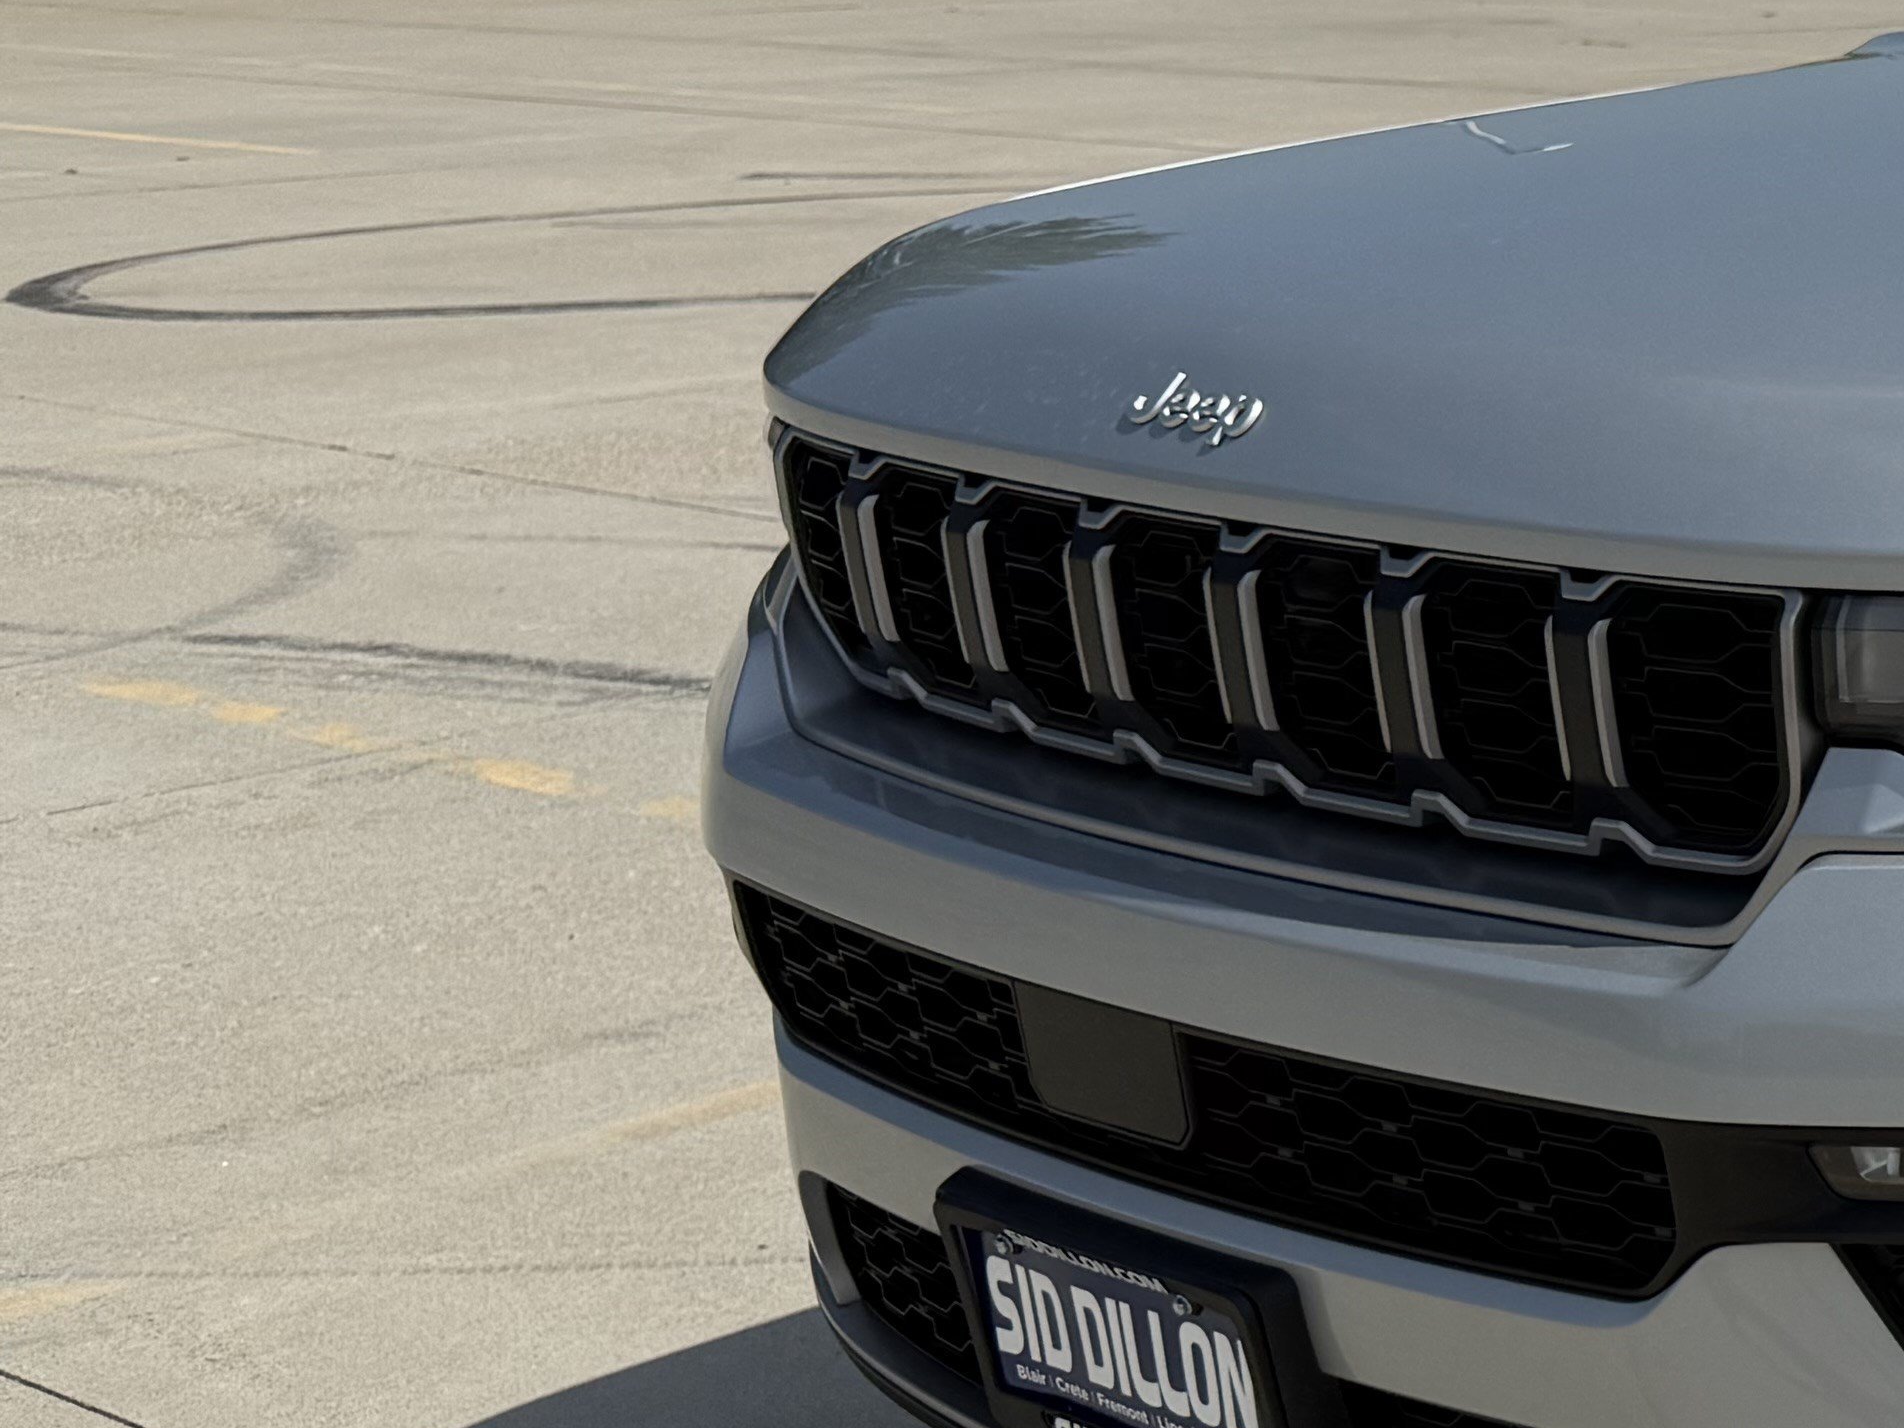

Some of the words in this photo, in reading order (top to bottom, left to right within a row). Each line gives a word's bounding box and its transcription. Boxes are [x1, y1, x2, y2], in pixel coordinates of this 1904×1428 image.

[1126, 371, 1264, 446] Jeep
[986, 1254, 1072, 1374] SID
[1016, 1363, 1046, 1386] Blair
[1055, 1375, 1090, 1401] Crete
[1097, 1392, 1150, 1426] Fremont
